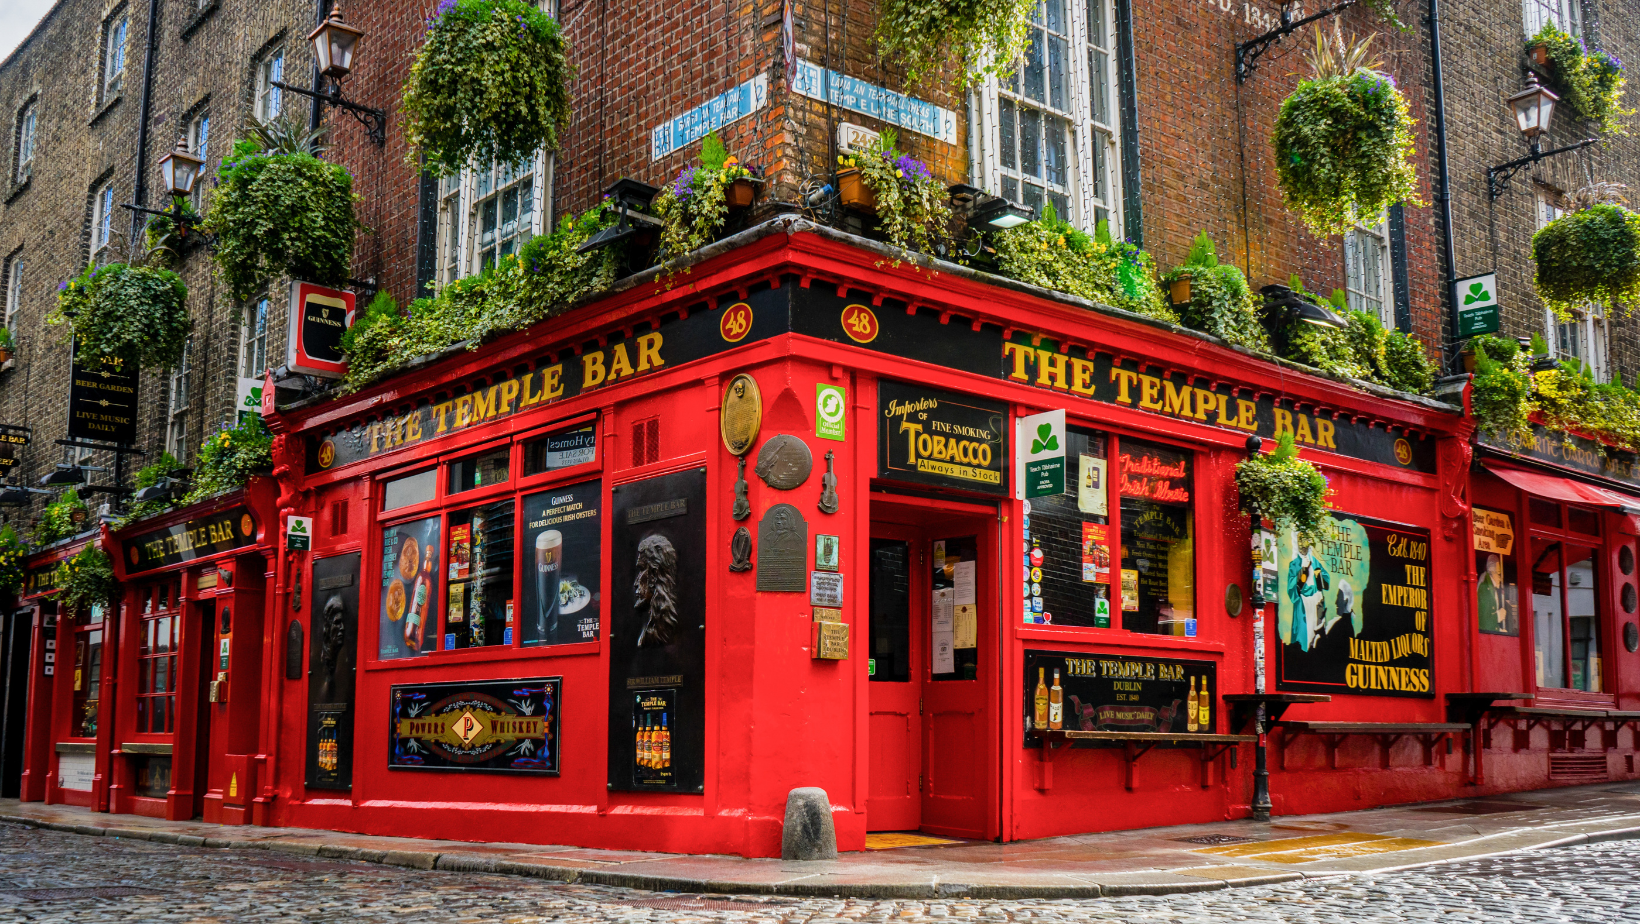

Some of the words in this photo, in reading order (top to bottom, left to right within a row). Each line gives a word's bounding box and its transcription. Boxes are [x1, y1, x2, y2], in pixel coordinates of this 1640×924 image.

[853, 83, 866, 97] AN
[685, 117, 717, 141] TEMPLE
[720, 107, 738, 124] BAR
[900, 112, 933, 134] SOUTH
[308, 315, 342, 327] GUINNESS
[725, 309, 748, 336] 48
[848, 313, 872, 335] 48
[75, 379, 98, 389] BEER
[99, 383, 134, 394] GARDEN
[367, 413, 423, 456] THE
[433, 363, 565, 433] TEMPLE
[582, 331, 666, 391] BAR
[1003, 341, 1096, 398] THE
[1111, 366, 1259, 432] TEMPLE
[1272, 406, 1337, 451] BAR
[76, 411, 98, 420] LIVE
[100, 414, 130, 425] MUSIC
[885, 397, 938, 420] Importers
[918, 412, 928, 421] OF
[88, 422, 117, 432] DAILY
[821, 427, 841, 436] Member
[822, 421, 840, 430] Official
[932, 420, 952, 433] FINE
[952, 424, 991, 440] SMOKING
[321, 445, 334, 463] 48
[919, 460, 954, 476] Always
[959, 467, 968, 477] in
[972, 468, 999, 482] Stock
[1119, 453, 1187, 478] Traditional
[1119, 474, 1150, 497] Irish
[547, 506, 566, 516] PERFECT
[566, 502, 583, 512] MATCH
[552, 494, 573, 505] GUINNESS
[529, 520, 538, 529] FOR
[539, 516, 562, 527] DELICIOUS
[563, 513, 575, 522] IRISH
[576, 509, 597, 520] OYSTERS
[1134, 511, 1163, 528] TEMPLE
[145, 539, 165, 560] THE
[166, 527, 207, 554] TEMPLE
[209, 520, 235, 545] BAR
[1320, 539, 1362, 561] TEMPLE
[1331, 557, 1353, 576] BAR
[1405, 564, 1426, 587] THE
[38, 573, 49, 586] THE
[1381, 583, 1427, 610] EMPEROR
[577, 623, 599, 632] TEMPLE
[1415, 611, 1427, 631] OF
[582, 630, 594, 638] BAR
[1349, 637, 1390, 663] MALTED
[1391, 633, 1429, 659] LIQUORS
[1065, 657, 1096, 677] THE
[1099, 659, 1155, 680] TEMPLE
[1158, 663, 1185, 682] BAR
[1345, 663, 1429, 692] GUINNESS
[1113, 681, 1142, 691] DUBLIN
[1099, 712, 1114, 720] LIVE
[1115, 711, 1134, 720] MUSIC
[1136, 711, 1155, 721] DAILY
[409, 720, 446, 735] POWERS
[463, 716, 474, 740] P
[490, 719, 538, 736] WHISKEY
